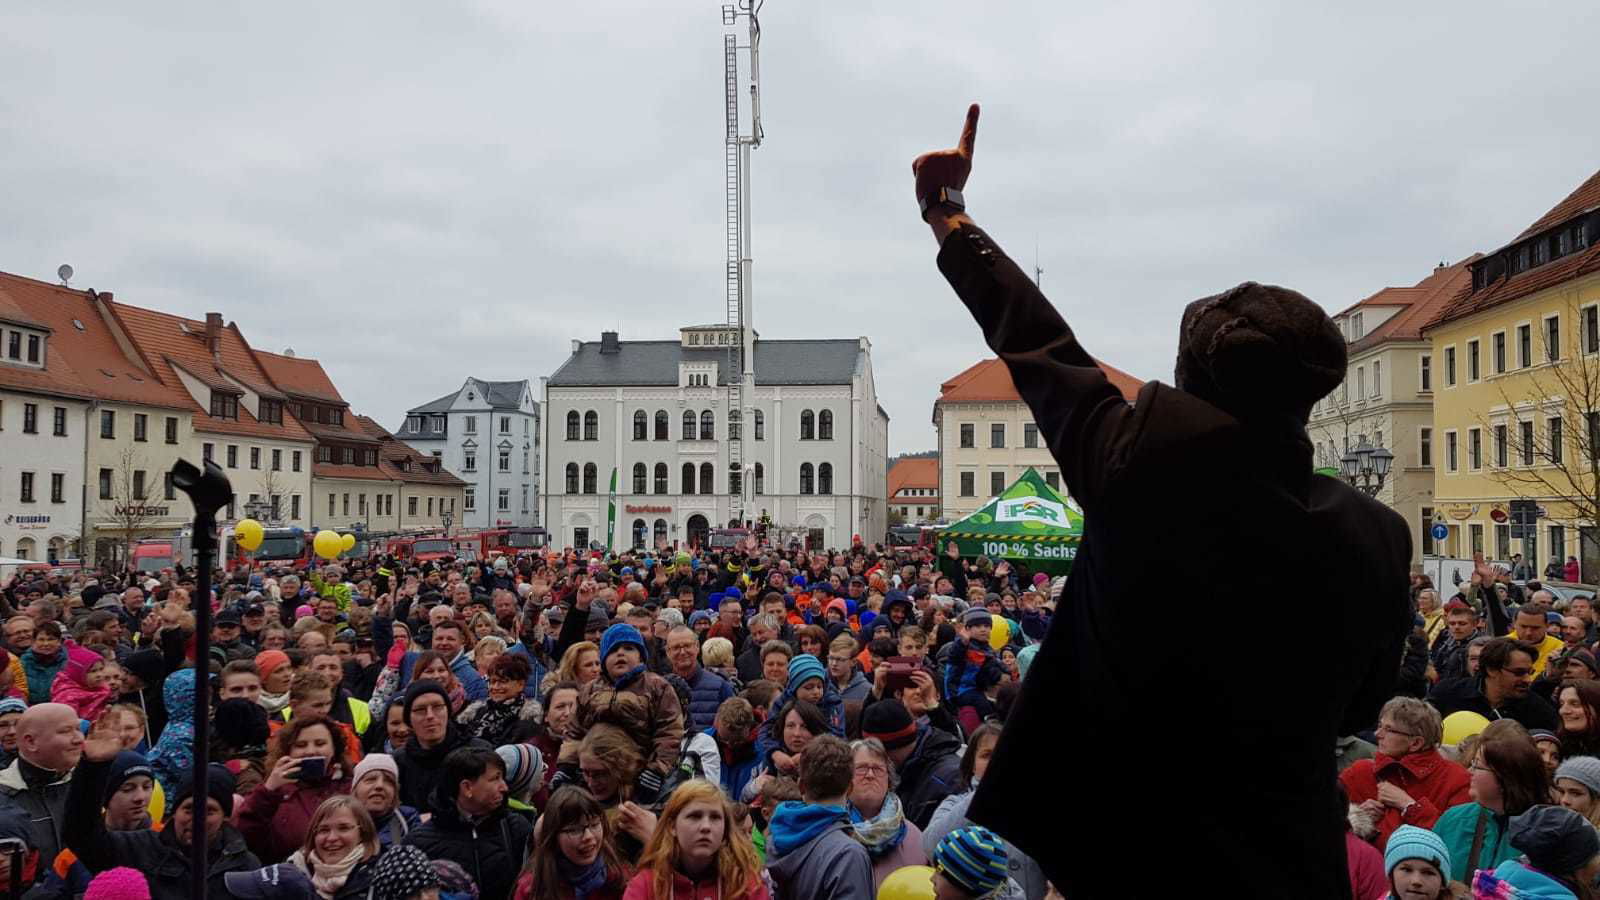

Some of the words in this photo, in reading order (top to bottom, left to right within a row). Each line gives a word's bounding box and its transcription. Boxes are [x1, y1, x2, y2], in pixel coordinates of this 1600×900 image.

[982, 542, 1008, 556] 100
[1012, 542, 1029, 557] %
[1033, 543, 1078, 558] Sachs
